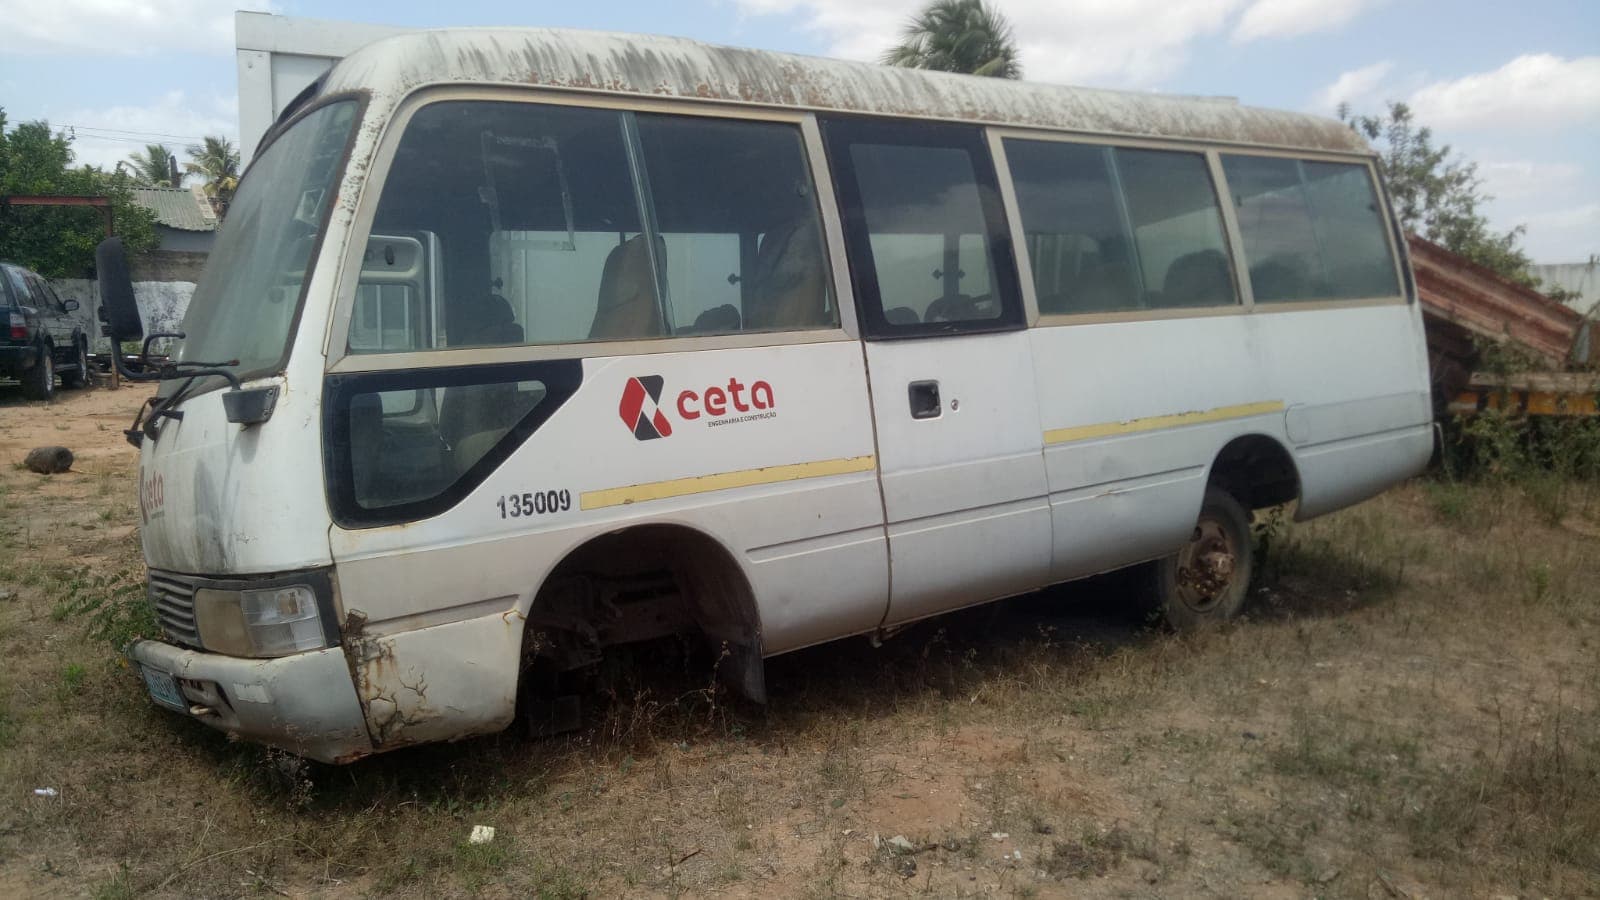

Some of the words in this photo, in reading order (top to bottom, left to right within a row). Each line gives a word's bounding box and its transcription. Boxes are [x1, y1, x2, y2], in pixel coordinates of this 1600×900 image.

[676, 377, 775, 420] ceta
[708, 418, 740, 428] ENGENHARIA
[744, 411, 777, 422] CONSTRUÇÃO
[496, 488, 571, 520] 135009
